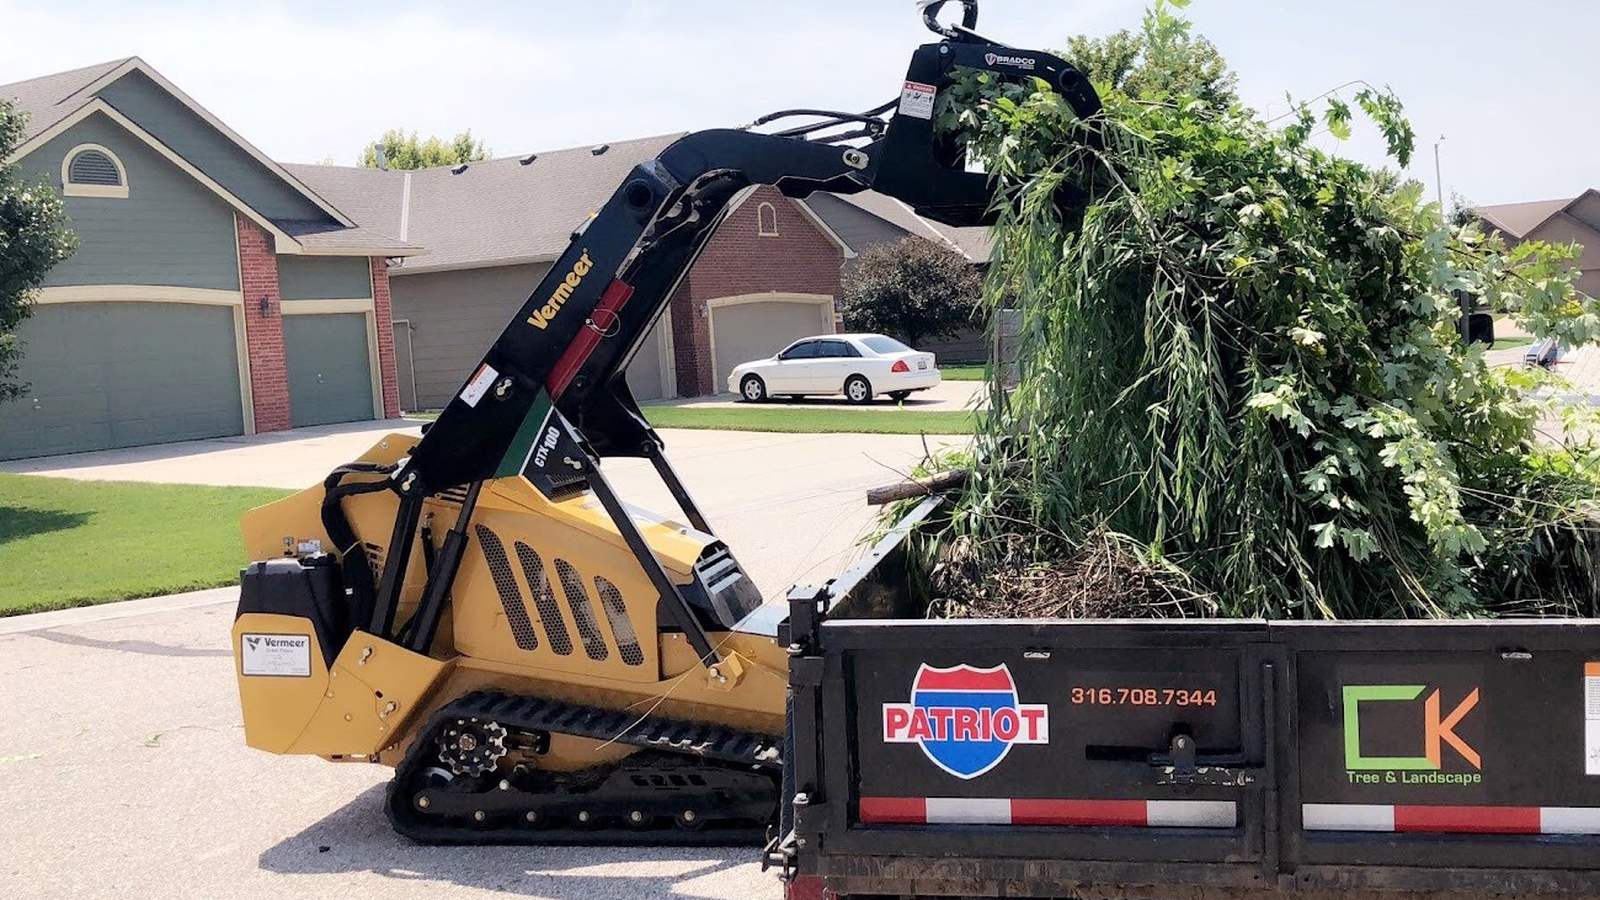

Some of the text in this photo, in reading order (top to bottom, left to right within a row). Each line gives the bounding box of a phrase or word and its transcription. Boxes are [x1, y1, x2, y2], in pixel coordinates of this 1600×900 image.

[997, 56, 1036, 65] BRADCO
[527, 251, 594, 330] Vermeer
[264, 637, 305, 648] Vermeer
[1071, 687, 1217, 706] 316.708.7344
[886, 707, 1045, 741] PATRIOT
[1343, 685, 1481, 770] CK
[1346, 771, 1482, 786] Tree & Landscape
